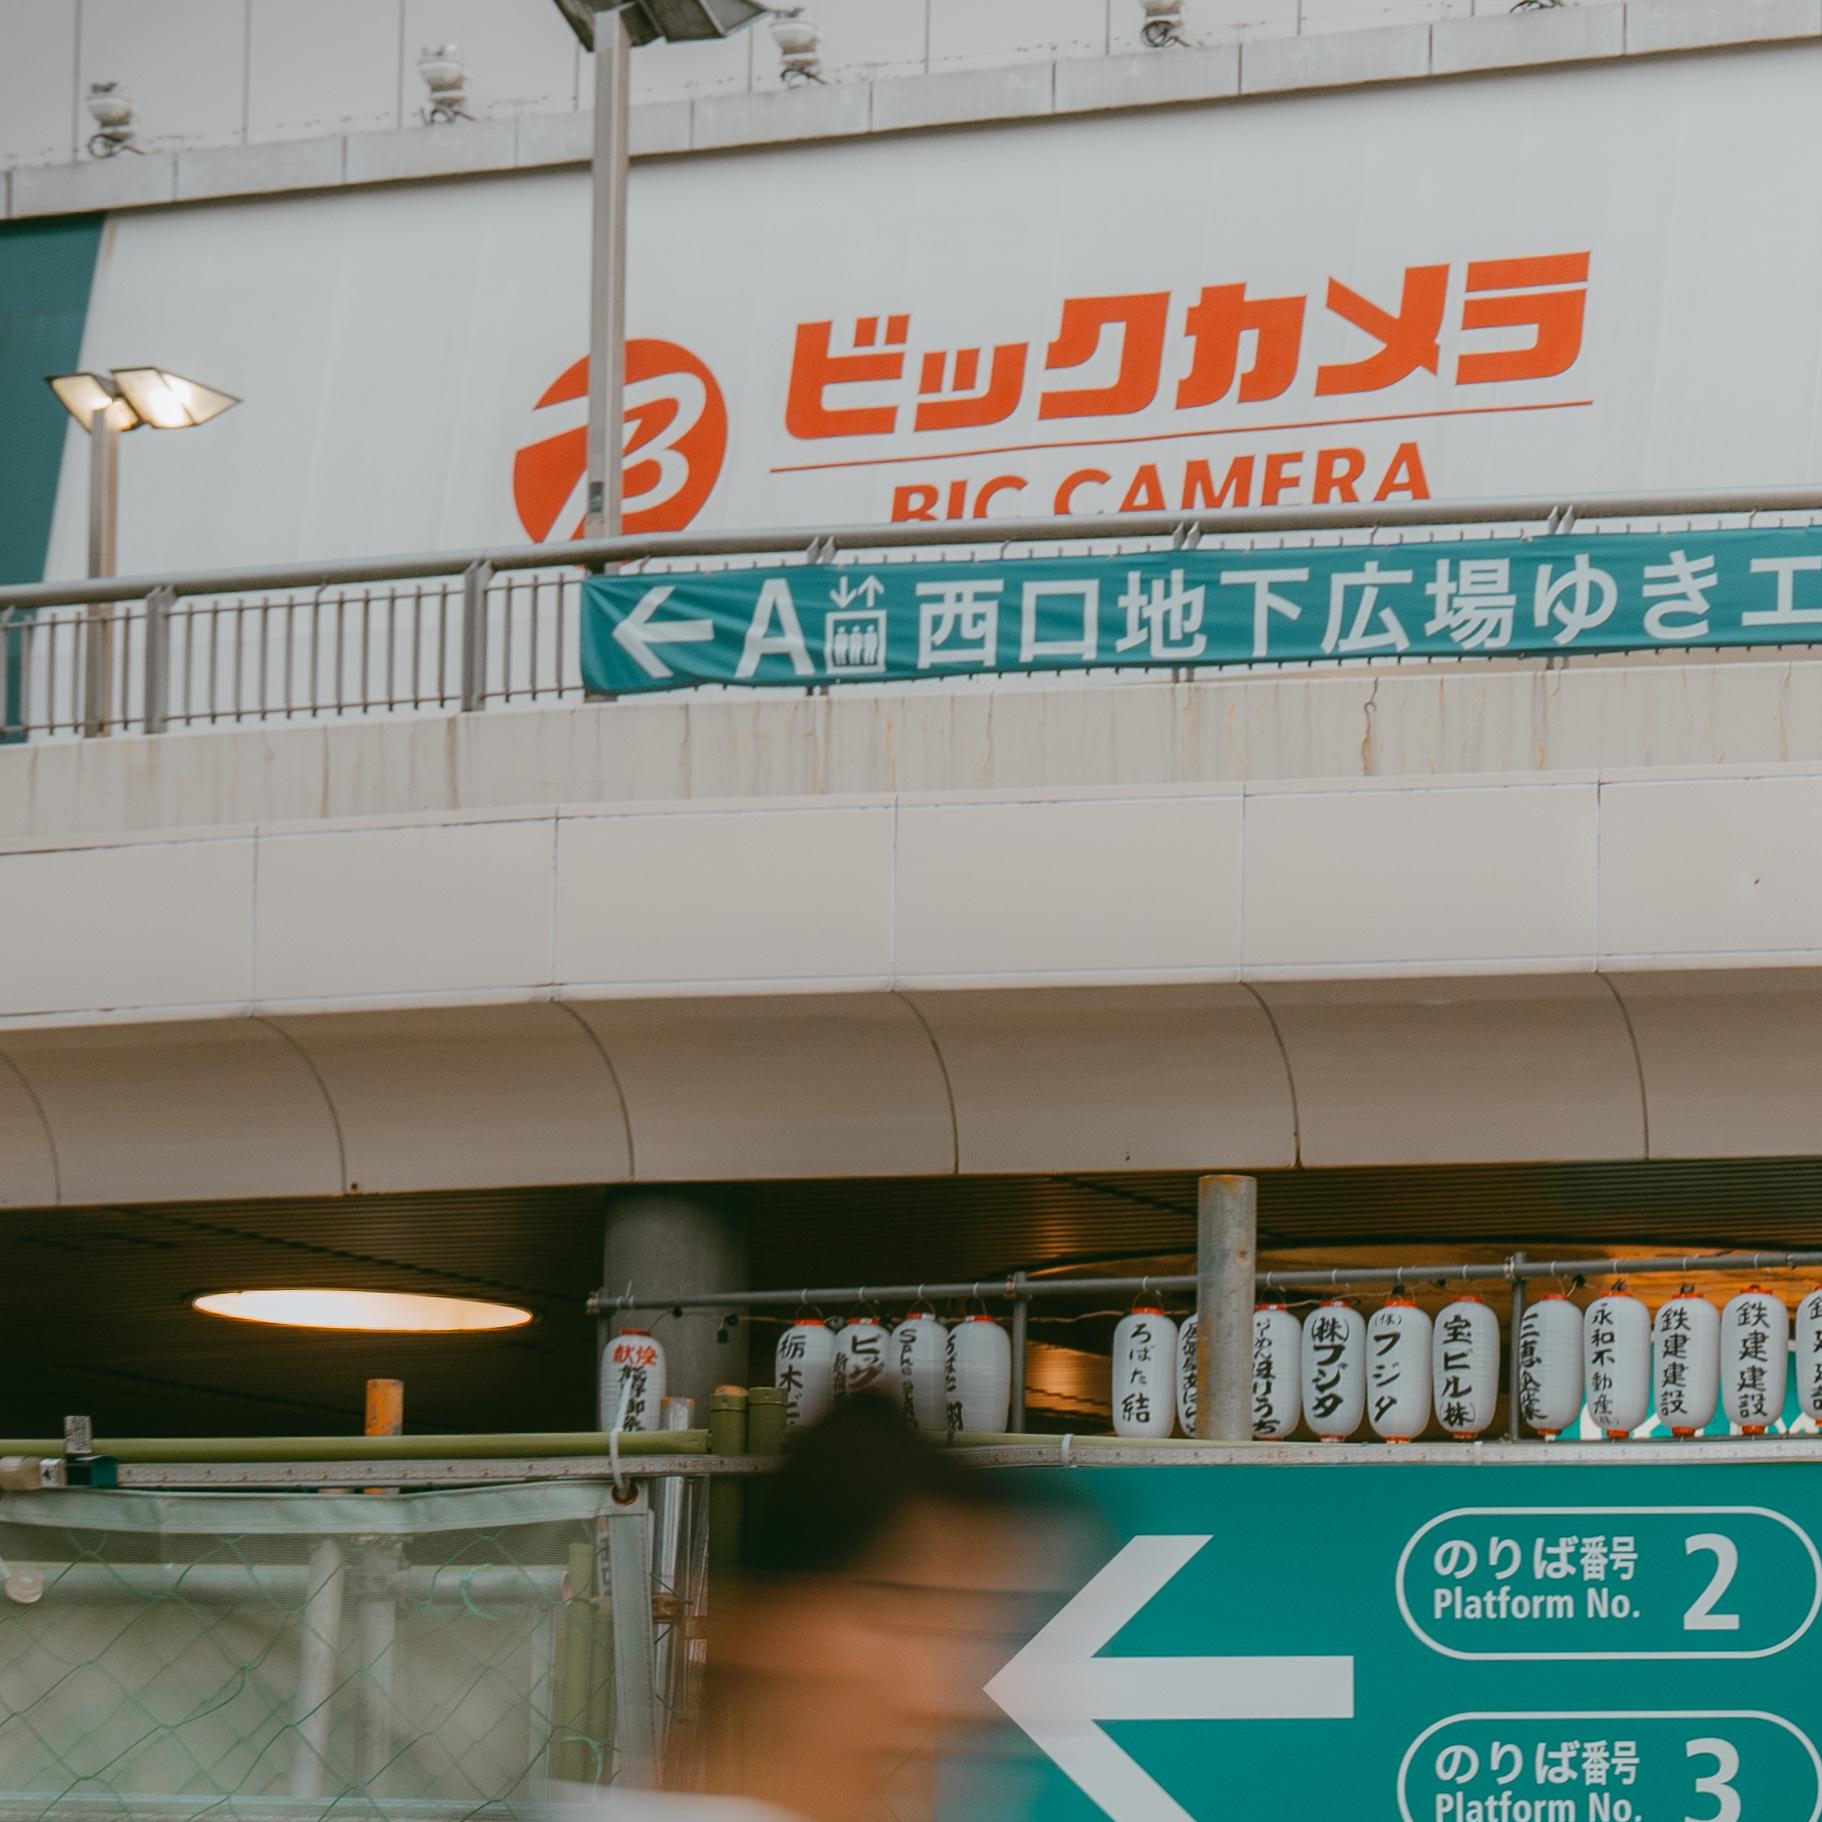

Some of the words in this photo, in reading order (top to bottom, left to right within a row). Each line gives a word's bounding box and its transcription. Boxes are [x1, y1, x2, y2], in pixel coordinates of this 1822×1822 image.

[783, 250, 1591, 441] ビックカメラ
[1053, 441, 1432, 516] CAMERA
[1433, 1536, 1638, 1580] のりば番号
[1682, 1533, 1741, 1631] 2
[1433, 1586, 1574, 1620] Platform
[1587, 1586, 1641, 1620] No.
[1434, 1739, 1640, 1786] のりば番号
